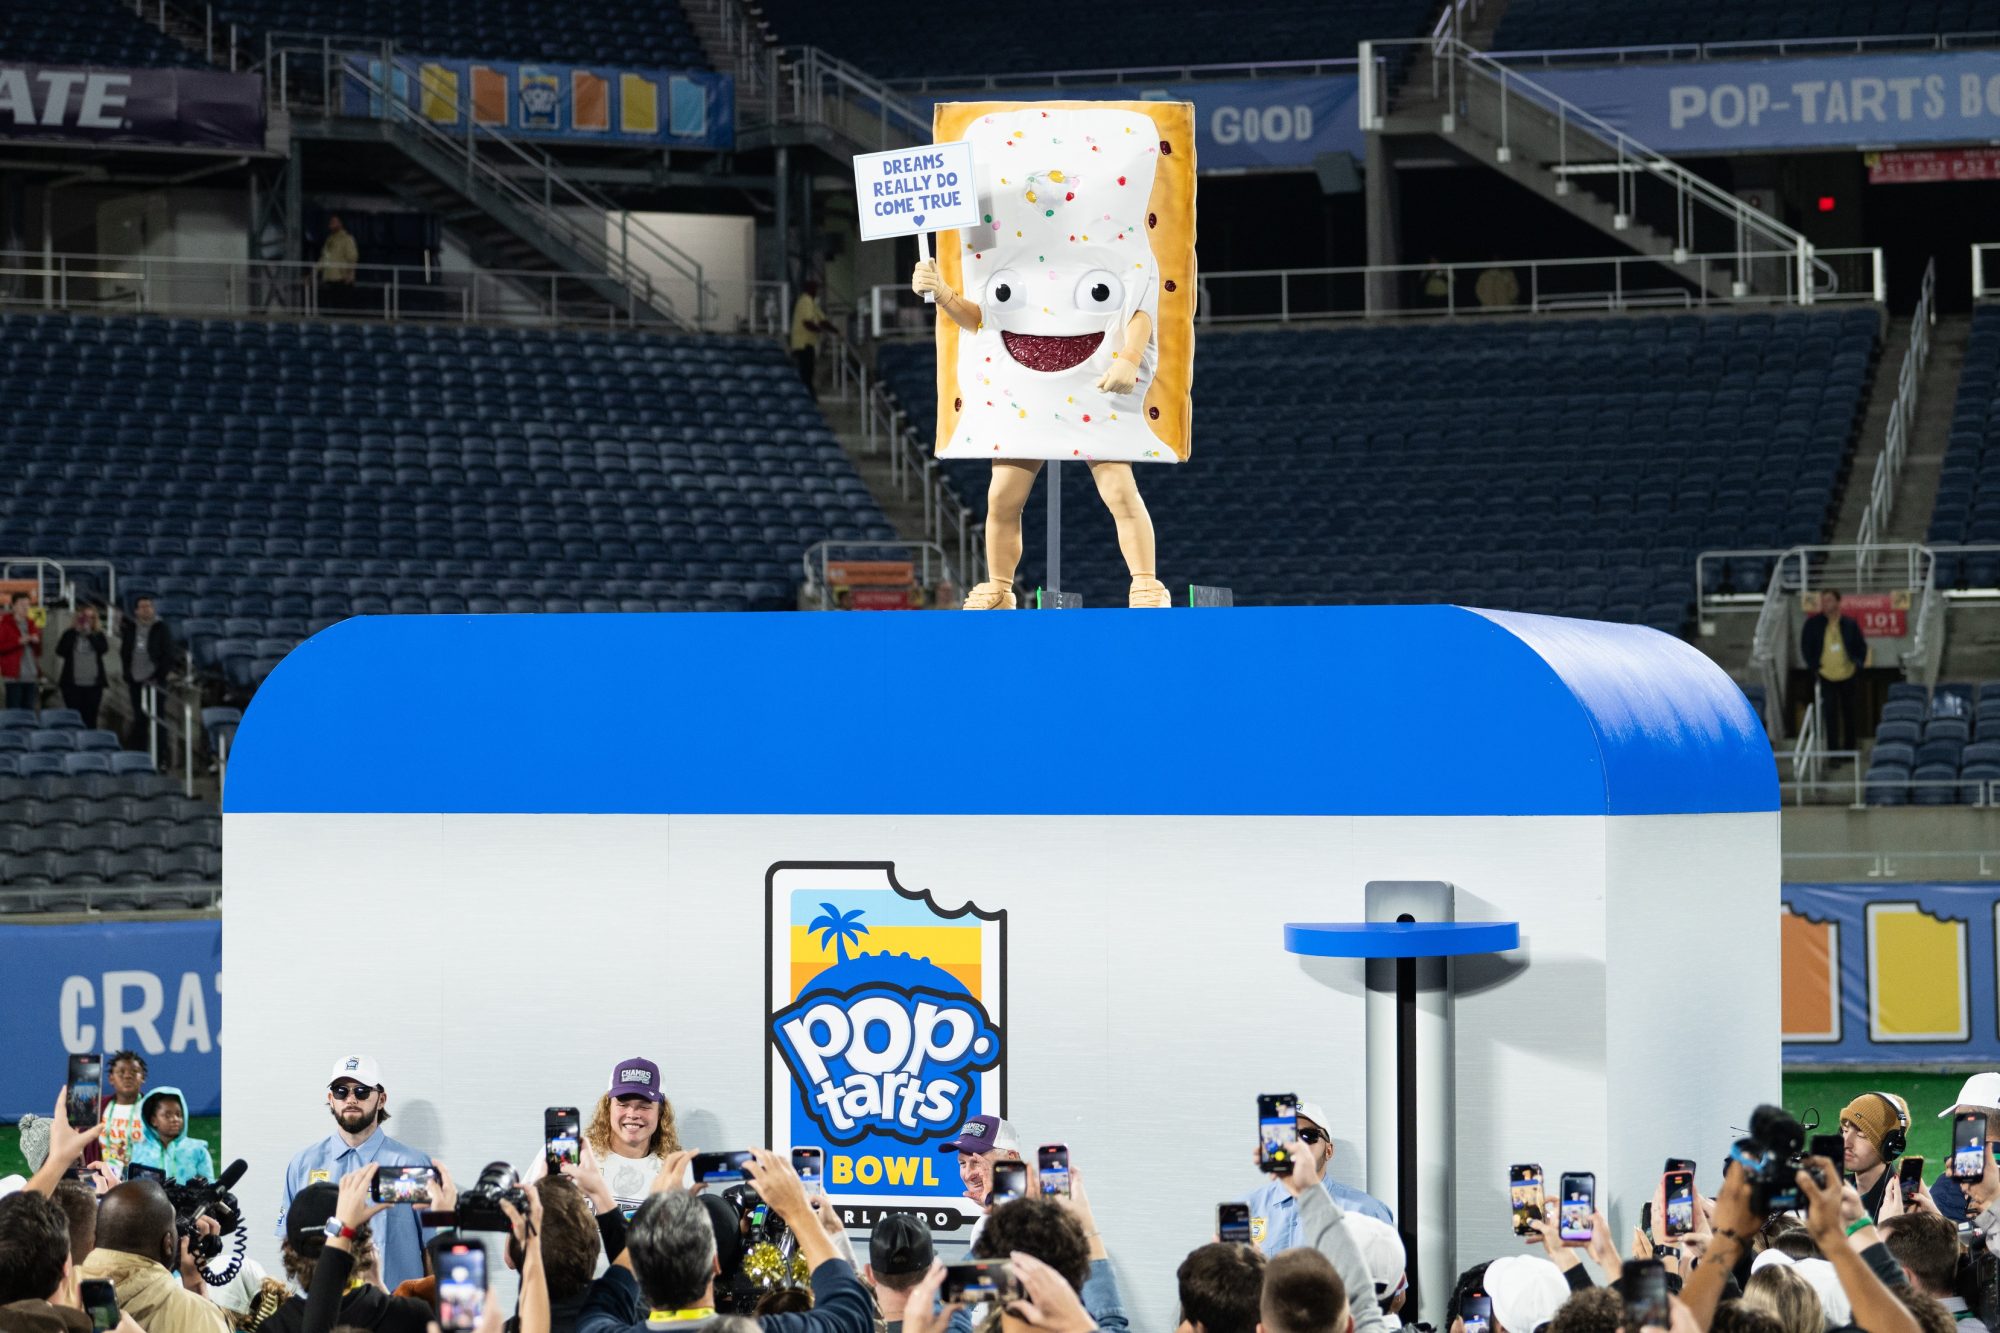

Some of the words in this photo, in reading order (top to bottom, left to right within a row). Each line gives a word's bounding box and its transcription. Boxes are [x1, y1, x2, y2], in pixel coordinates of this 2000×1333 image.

[1668, 73, 1945, 130] POP-TARTS
[1211, 104, 1314, 146] GOOD
[882, 153, 945, 176] DREAMS
[873, 174, 932, 197] REALLY
[937, 172, 958, 188] DO
[874, 197, 915, 216] COME
[918, 190, 961, 210] TRUE
[1863, 612, 1897, 627] 101
[59, 969, 222, 1055] CRA
[621, 1069, 652, 1080] CHAMPS
[815, 1071, 960, 1132] tarts
[831, 1155, 939, 1186] BOWL
[843, 1210, 948, 1226] RLADO
